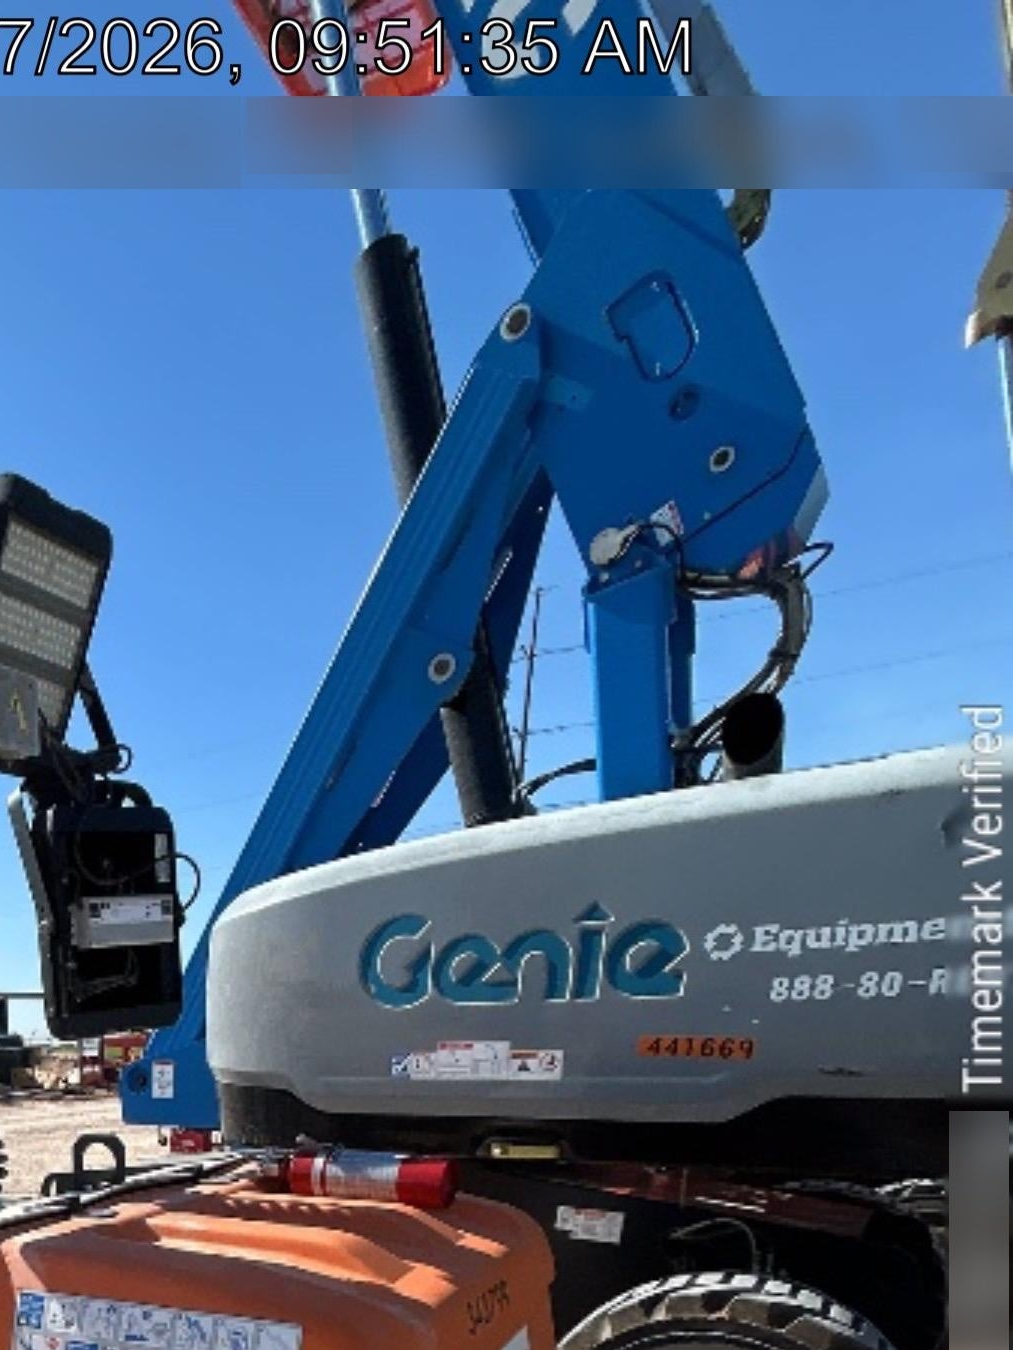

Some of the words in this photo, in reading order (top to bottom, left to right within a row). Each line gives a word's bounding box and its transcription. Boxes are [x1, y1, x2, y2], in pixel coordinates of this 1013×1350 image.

[358, 900, 691, 1011] Genie
[749, 917, 960, 958] Equipme
[769, 967, 963, 1003] 888-80-R
